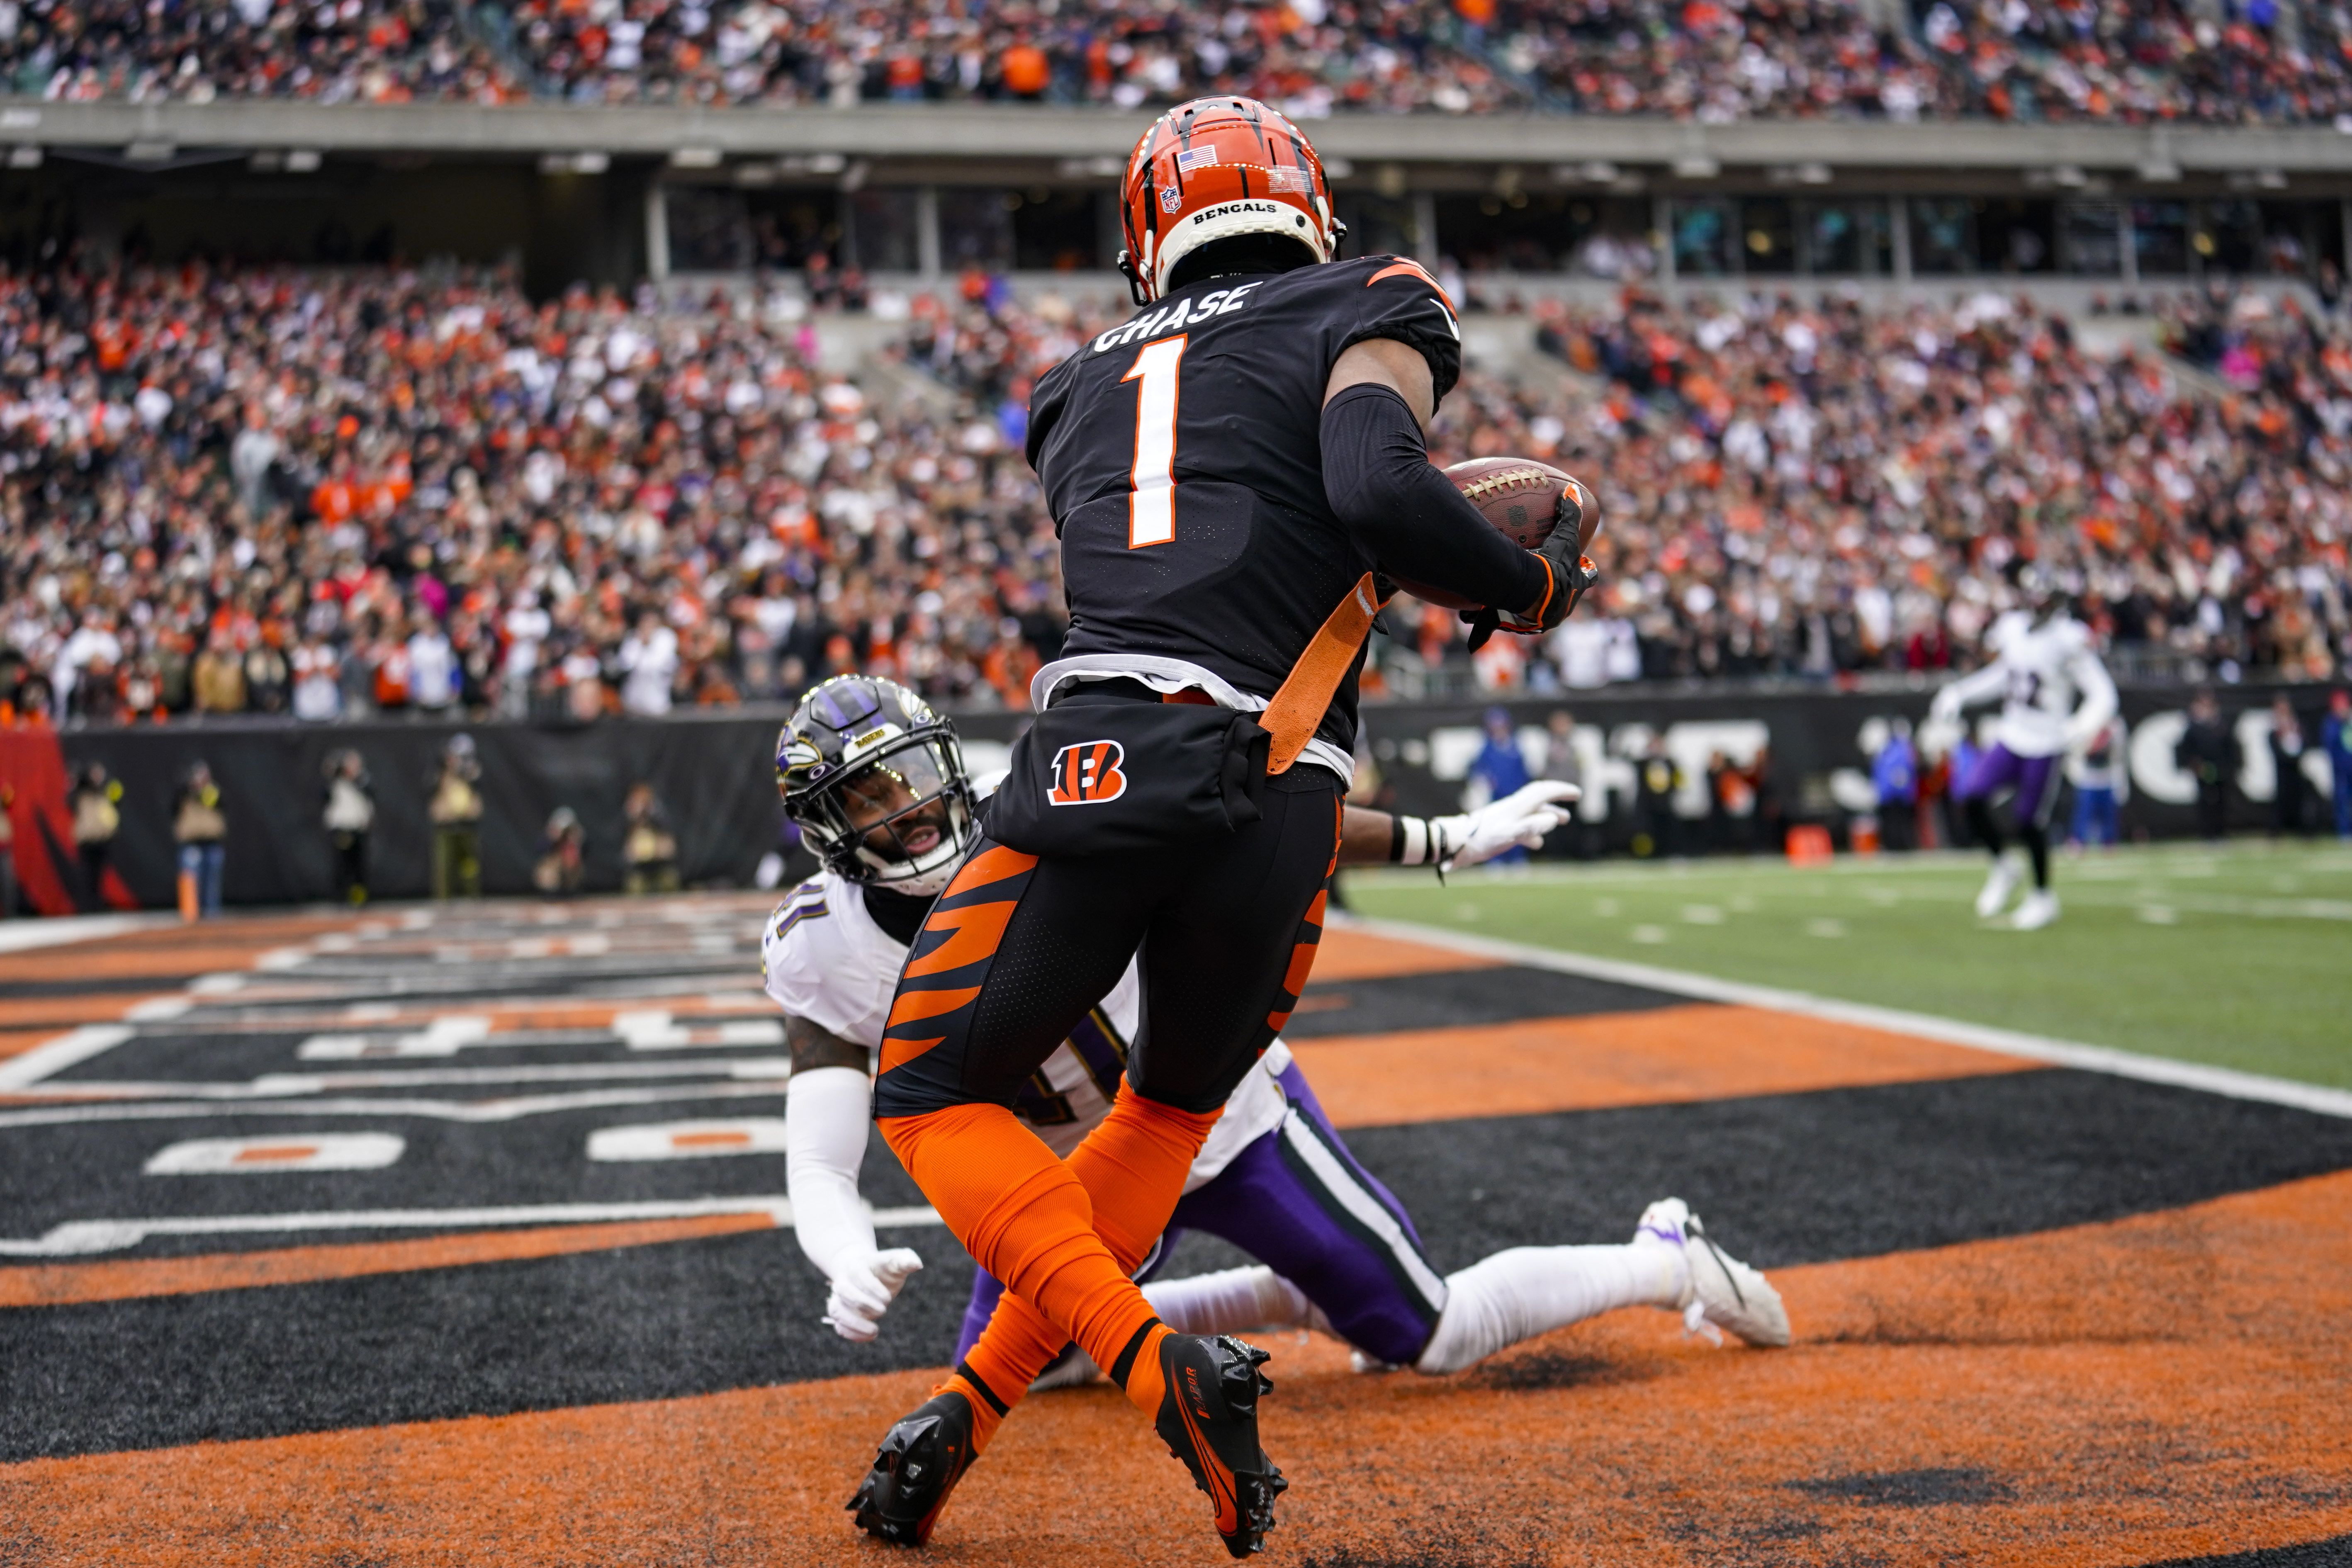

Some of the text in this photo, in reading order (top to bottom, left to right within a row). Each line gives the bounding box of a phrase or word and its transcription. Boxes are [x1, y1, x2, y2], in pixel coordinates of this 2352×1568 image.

[1164, 197, 1179, 210] NFL
[1193, 203, 1277, 225] BENGALS
[1094, 281, 1264, 352] CHASE
[1120, 333, 1188, 550] 1
[854, 728, 885, 748] RAVENS
[1046, 739, 1128, 806] B
